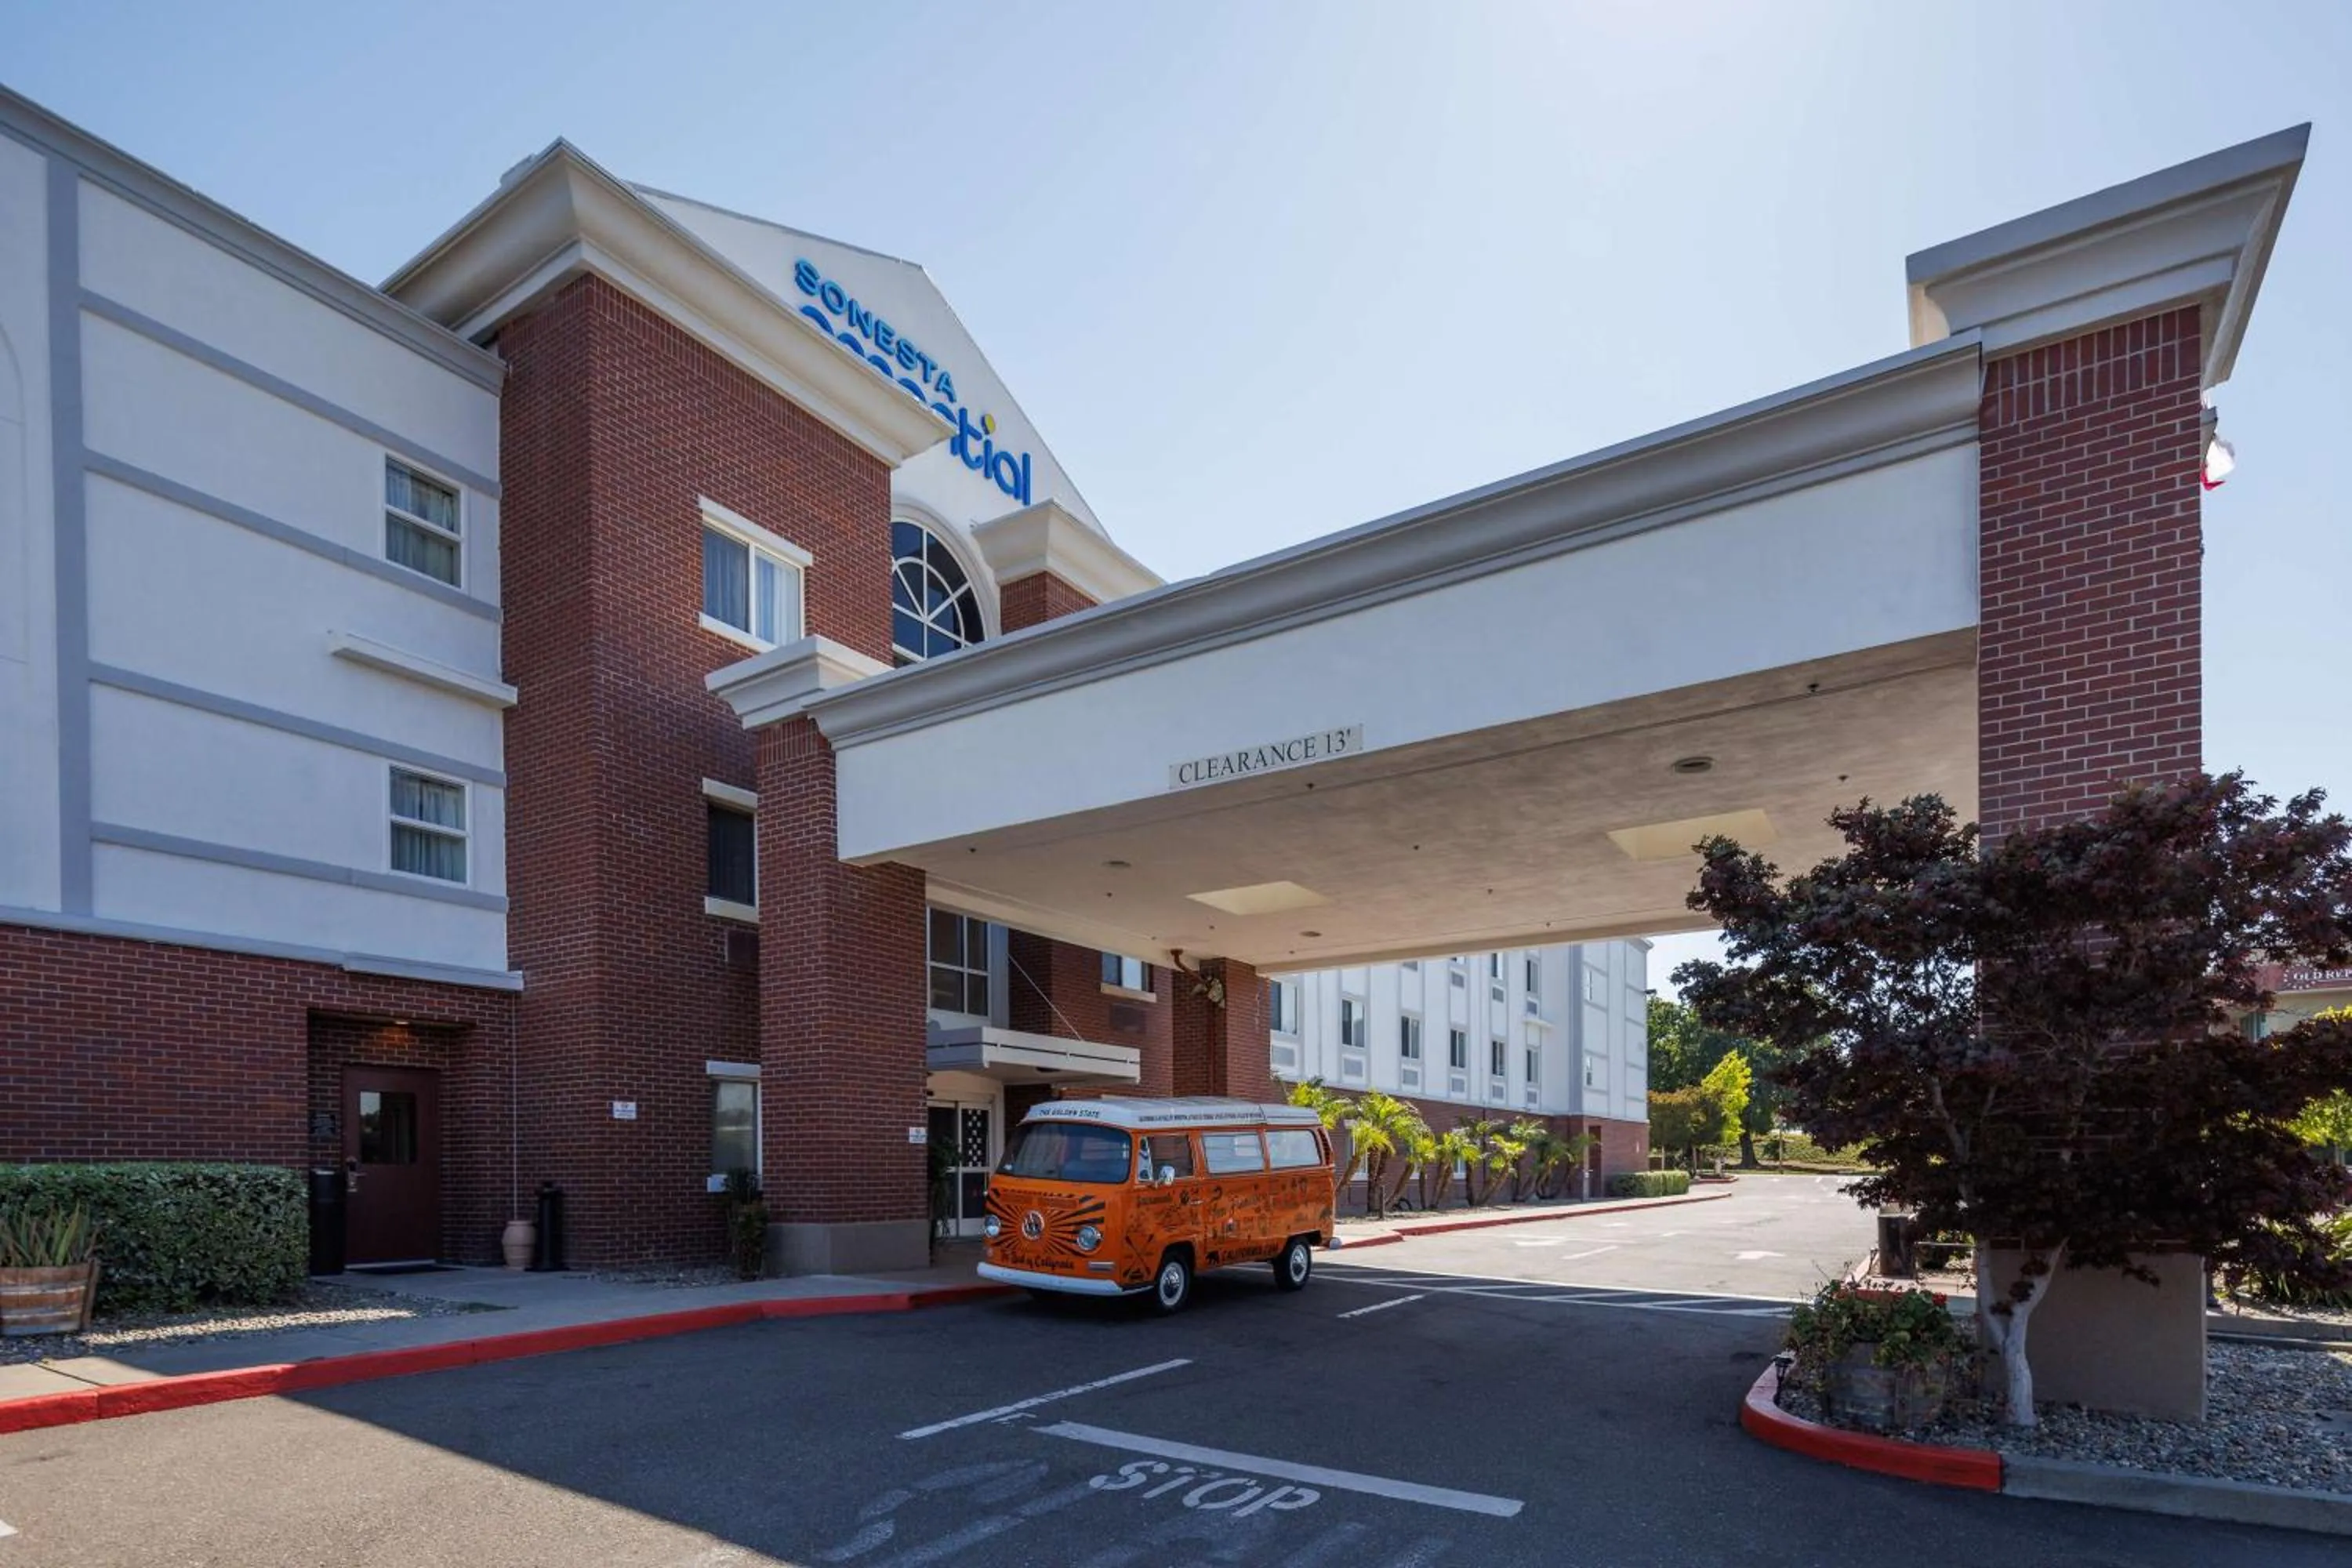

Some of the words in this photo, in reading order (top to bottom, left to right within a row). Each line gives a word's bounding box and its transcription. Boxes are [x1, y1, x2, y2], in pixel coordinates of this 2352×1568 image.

[794, 259, 956, 403] SONESTA
[950, 407, 1031, 506] tial
[1178, 736, 1317, 784] CLEARANCE
[1326, 728, 1352, 754] 13'
[1090, 1461, 1321, 1518] STOP
